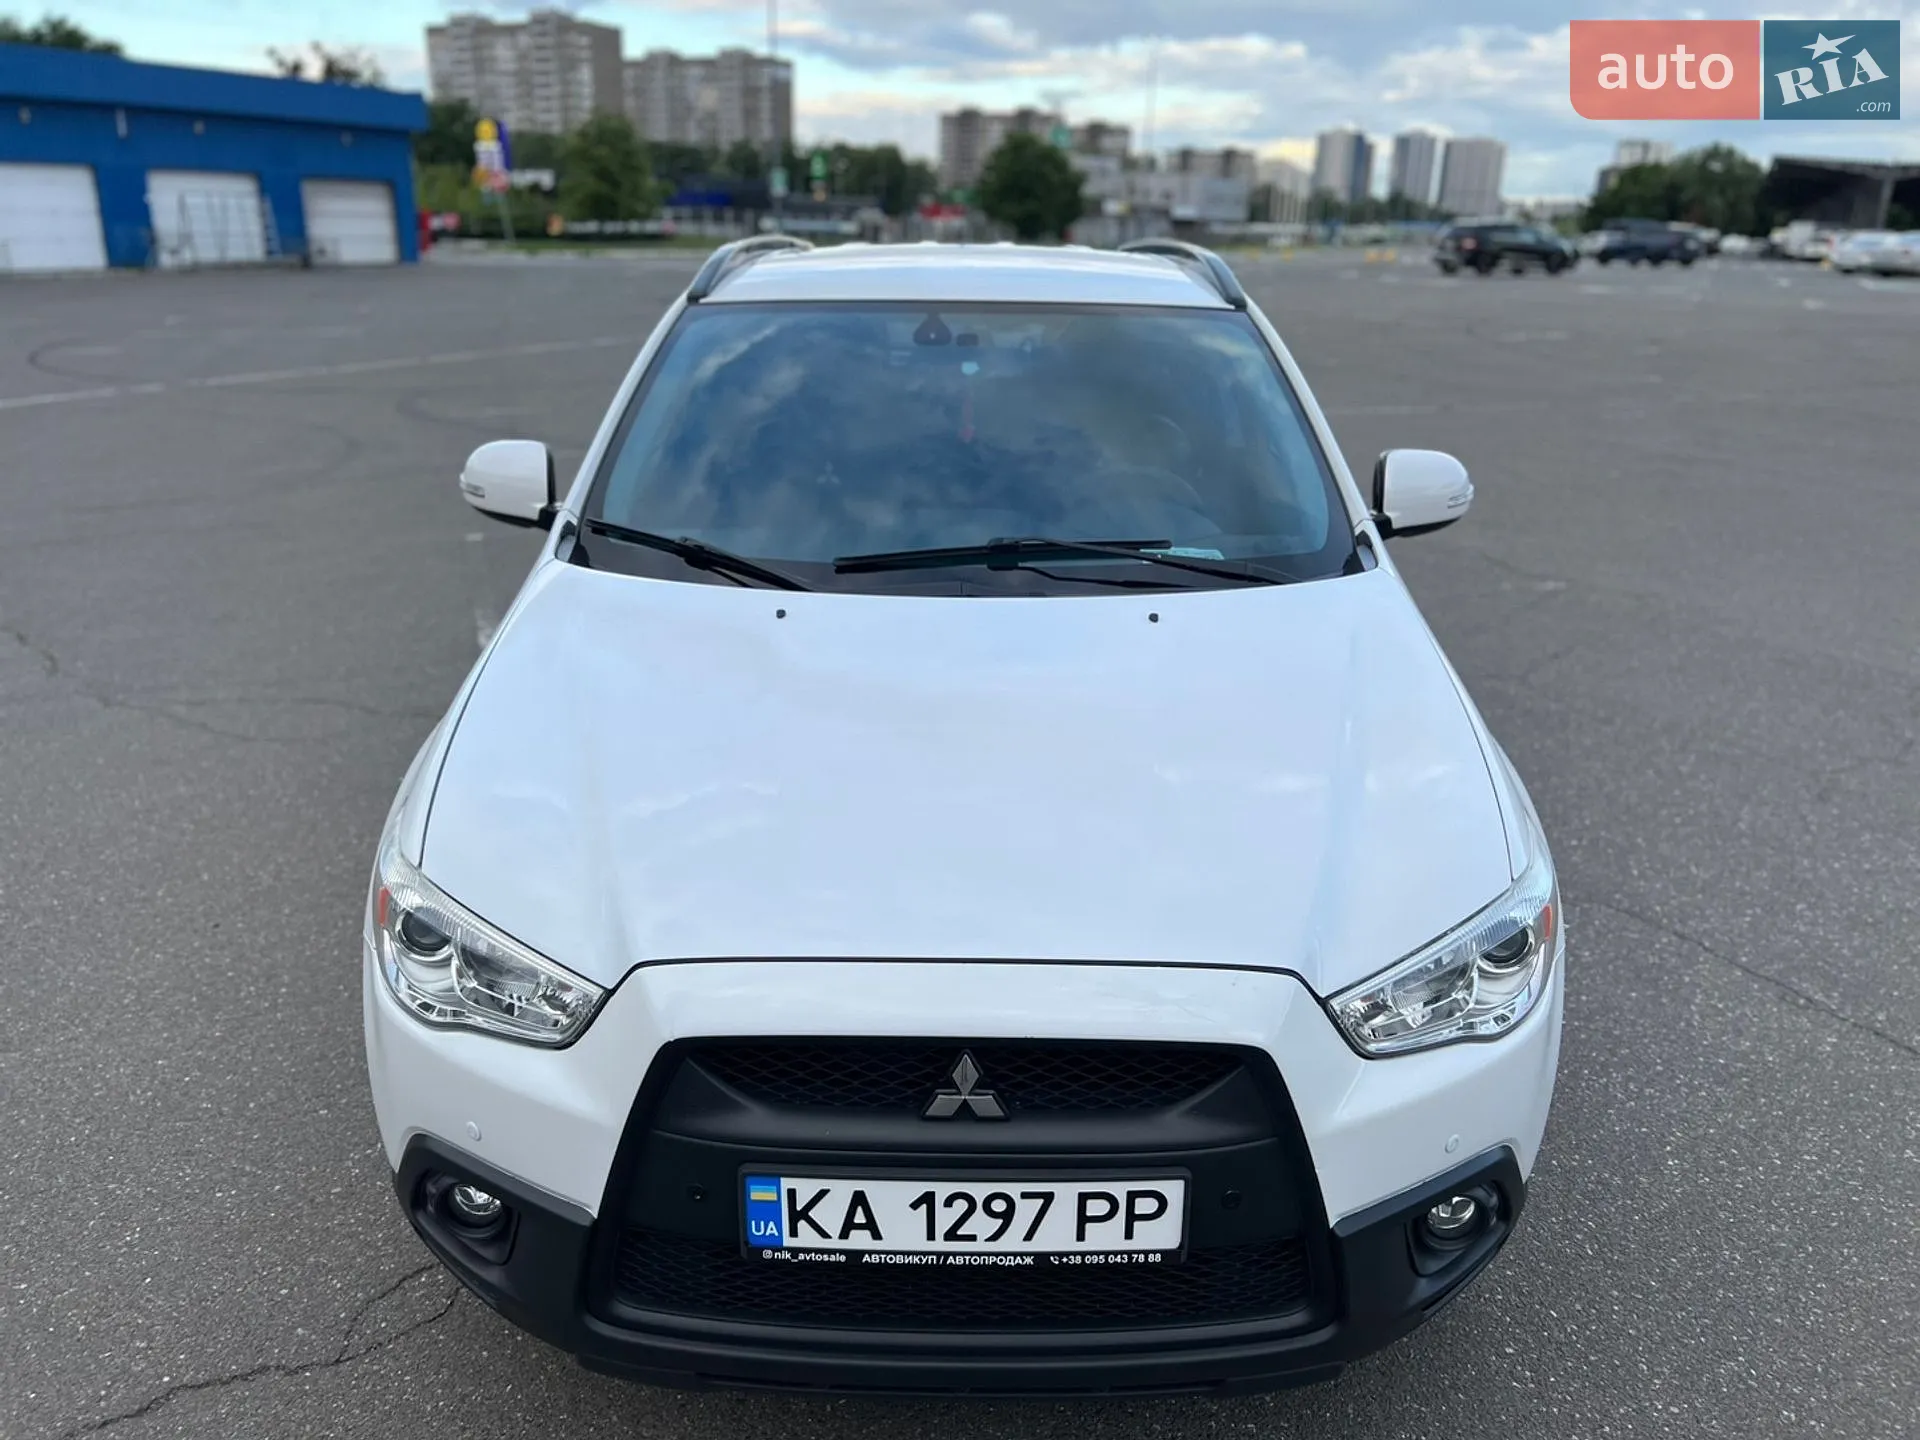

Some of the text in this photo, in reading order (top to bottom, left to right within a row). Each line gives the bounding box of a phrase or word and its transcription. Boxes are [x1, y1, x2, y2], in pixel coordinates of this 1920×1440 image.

[787, 1188, 1169, 1243] KA 1297 PP
[751, 1220, 779, 1237] UA
[862, 1253, 936, 1265] АВТОВИКУП
[946, 1255, 1035, 1266] АВТОПРОДАЖ
[1061, 1253, 1161, 1265] +38 095 043 78 88
